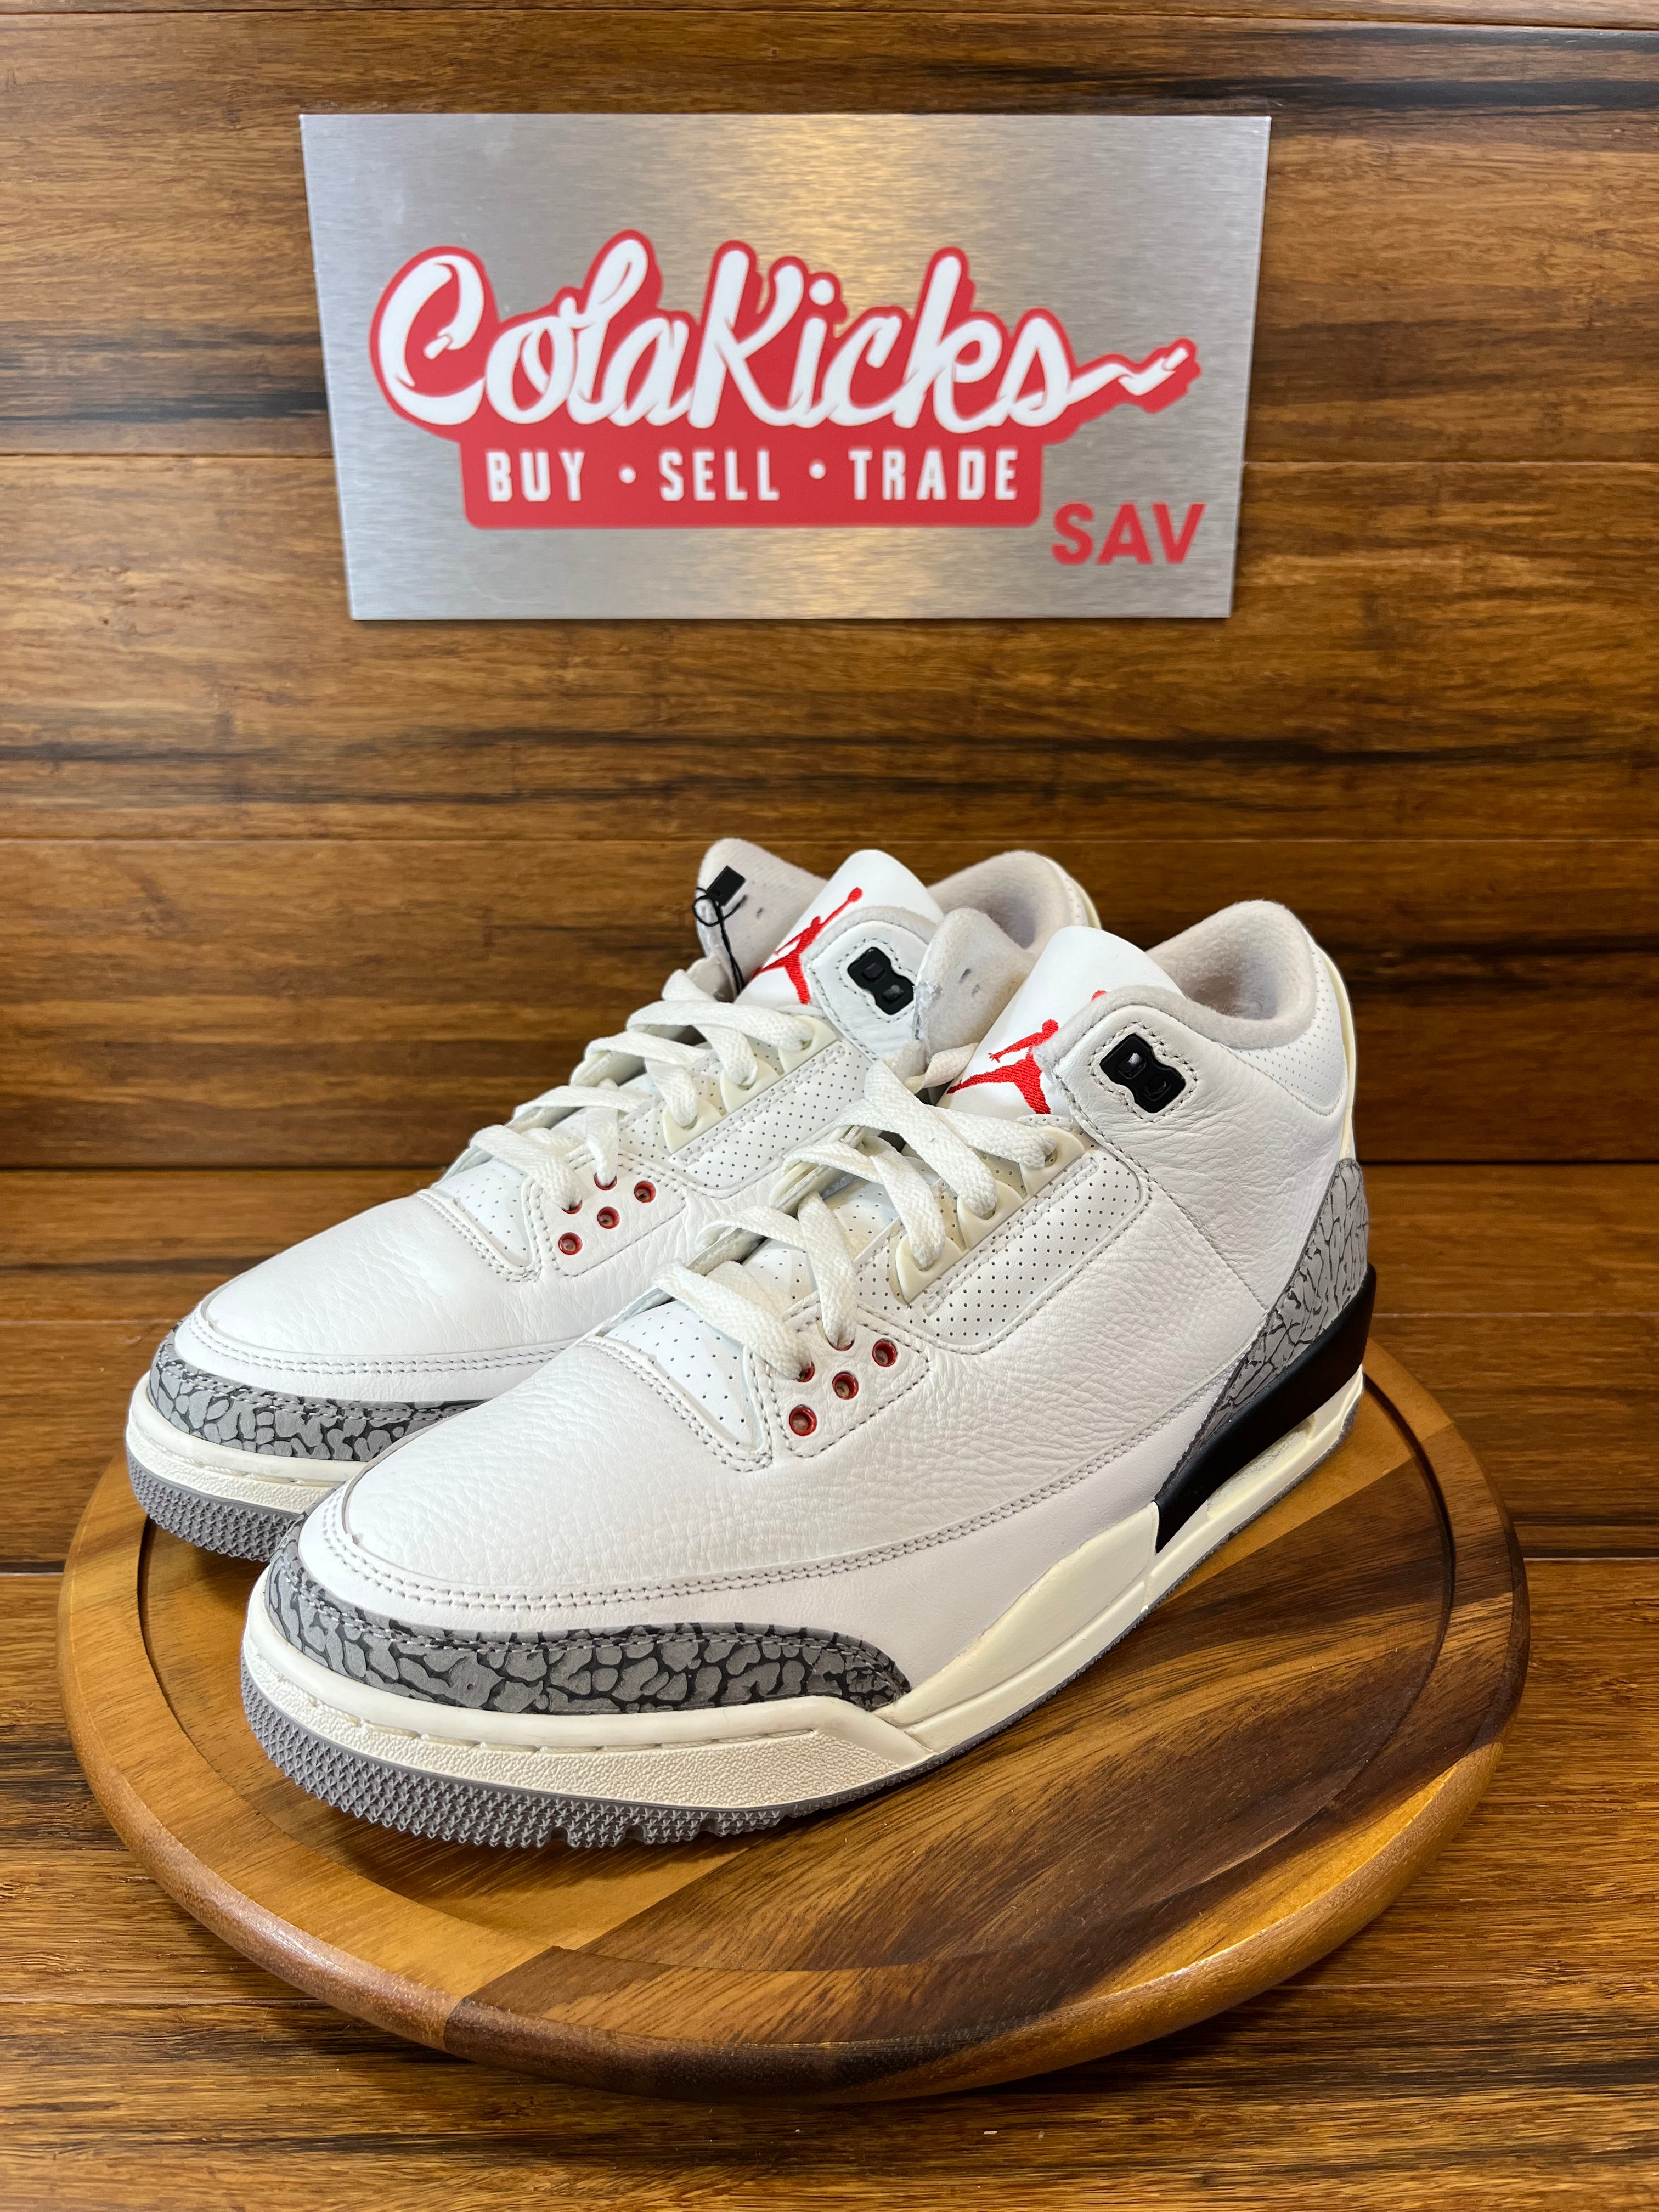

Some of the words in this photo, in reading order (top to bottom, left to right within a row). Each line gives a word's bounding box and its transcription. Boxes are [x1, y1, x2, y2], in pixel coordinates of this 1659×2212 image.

[486, 450, 585, 503] BUY
[659, 450, 780, 501] SELL
[849, 449, 1018, 500] TRADE
[1051, 501, 1207, 566] SAV
